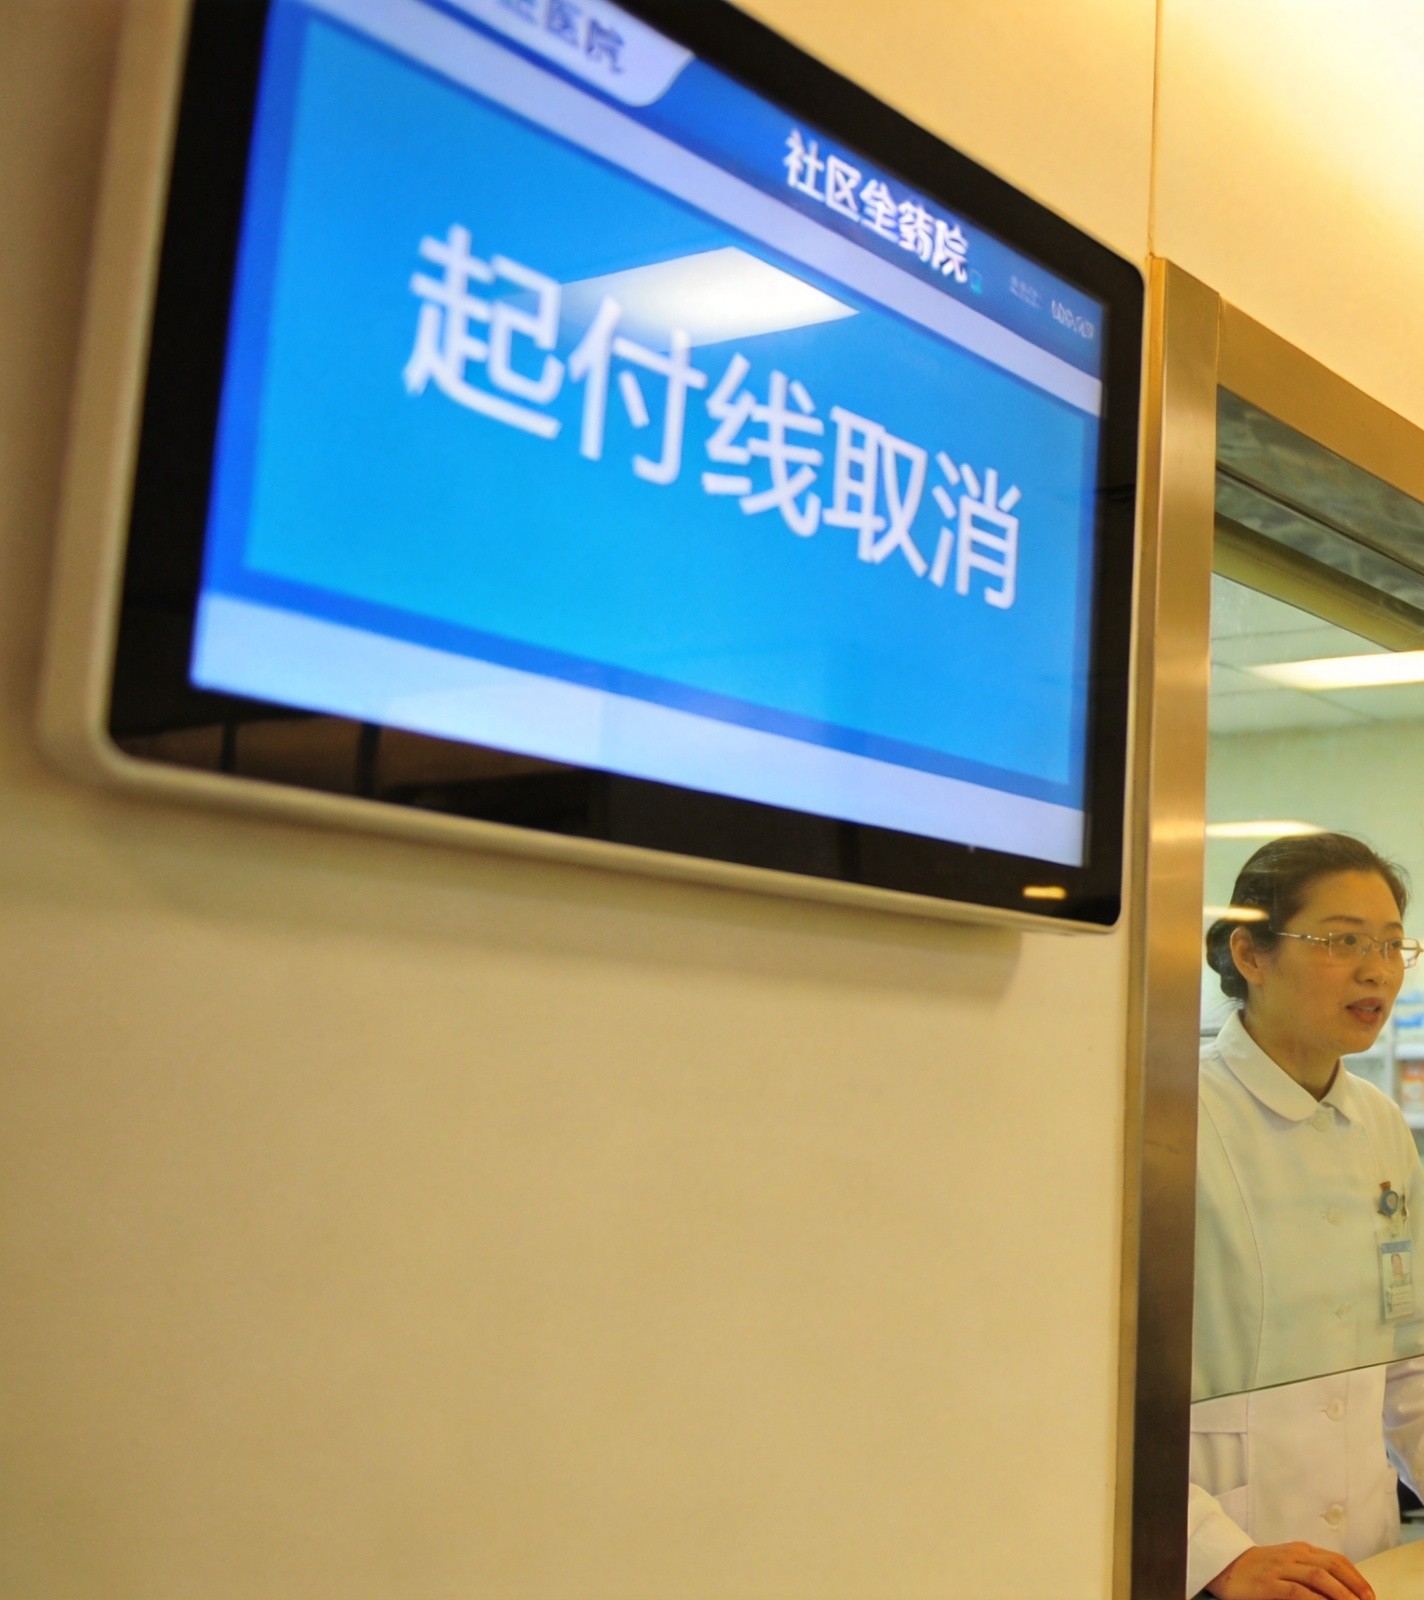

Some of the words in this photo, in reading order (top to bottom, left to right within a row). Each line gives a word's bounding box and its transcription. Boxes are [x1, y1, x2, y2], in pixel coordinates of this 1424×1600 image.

[404, 222, 1022, 610] 起付线取消
